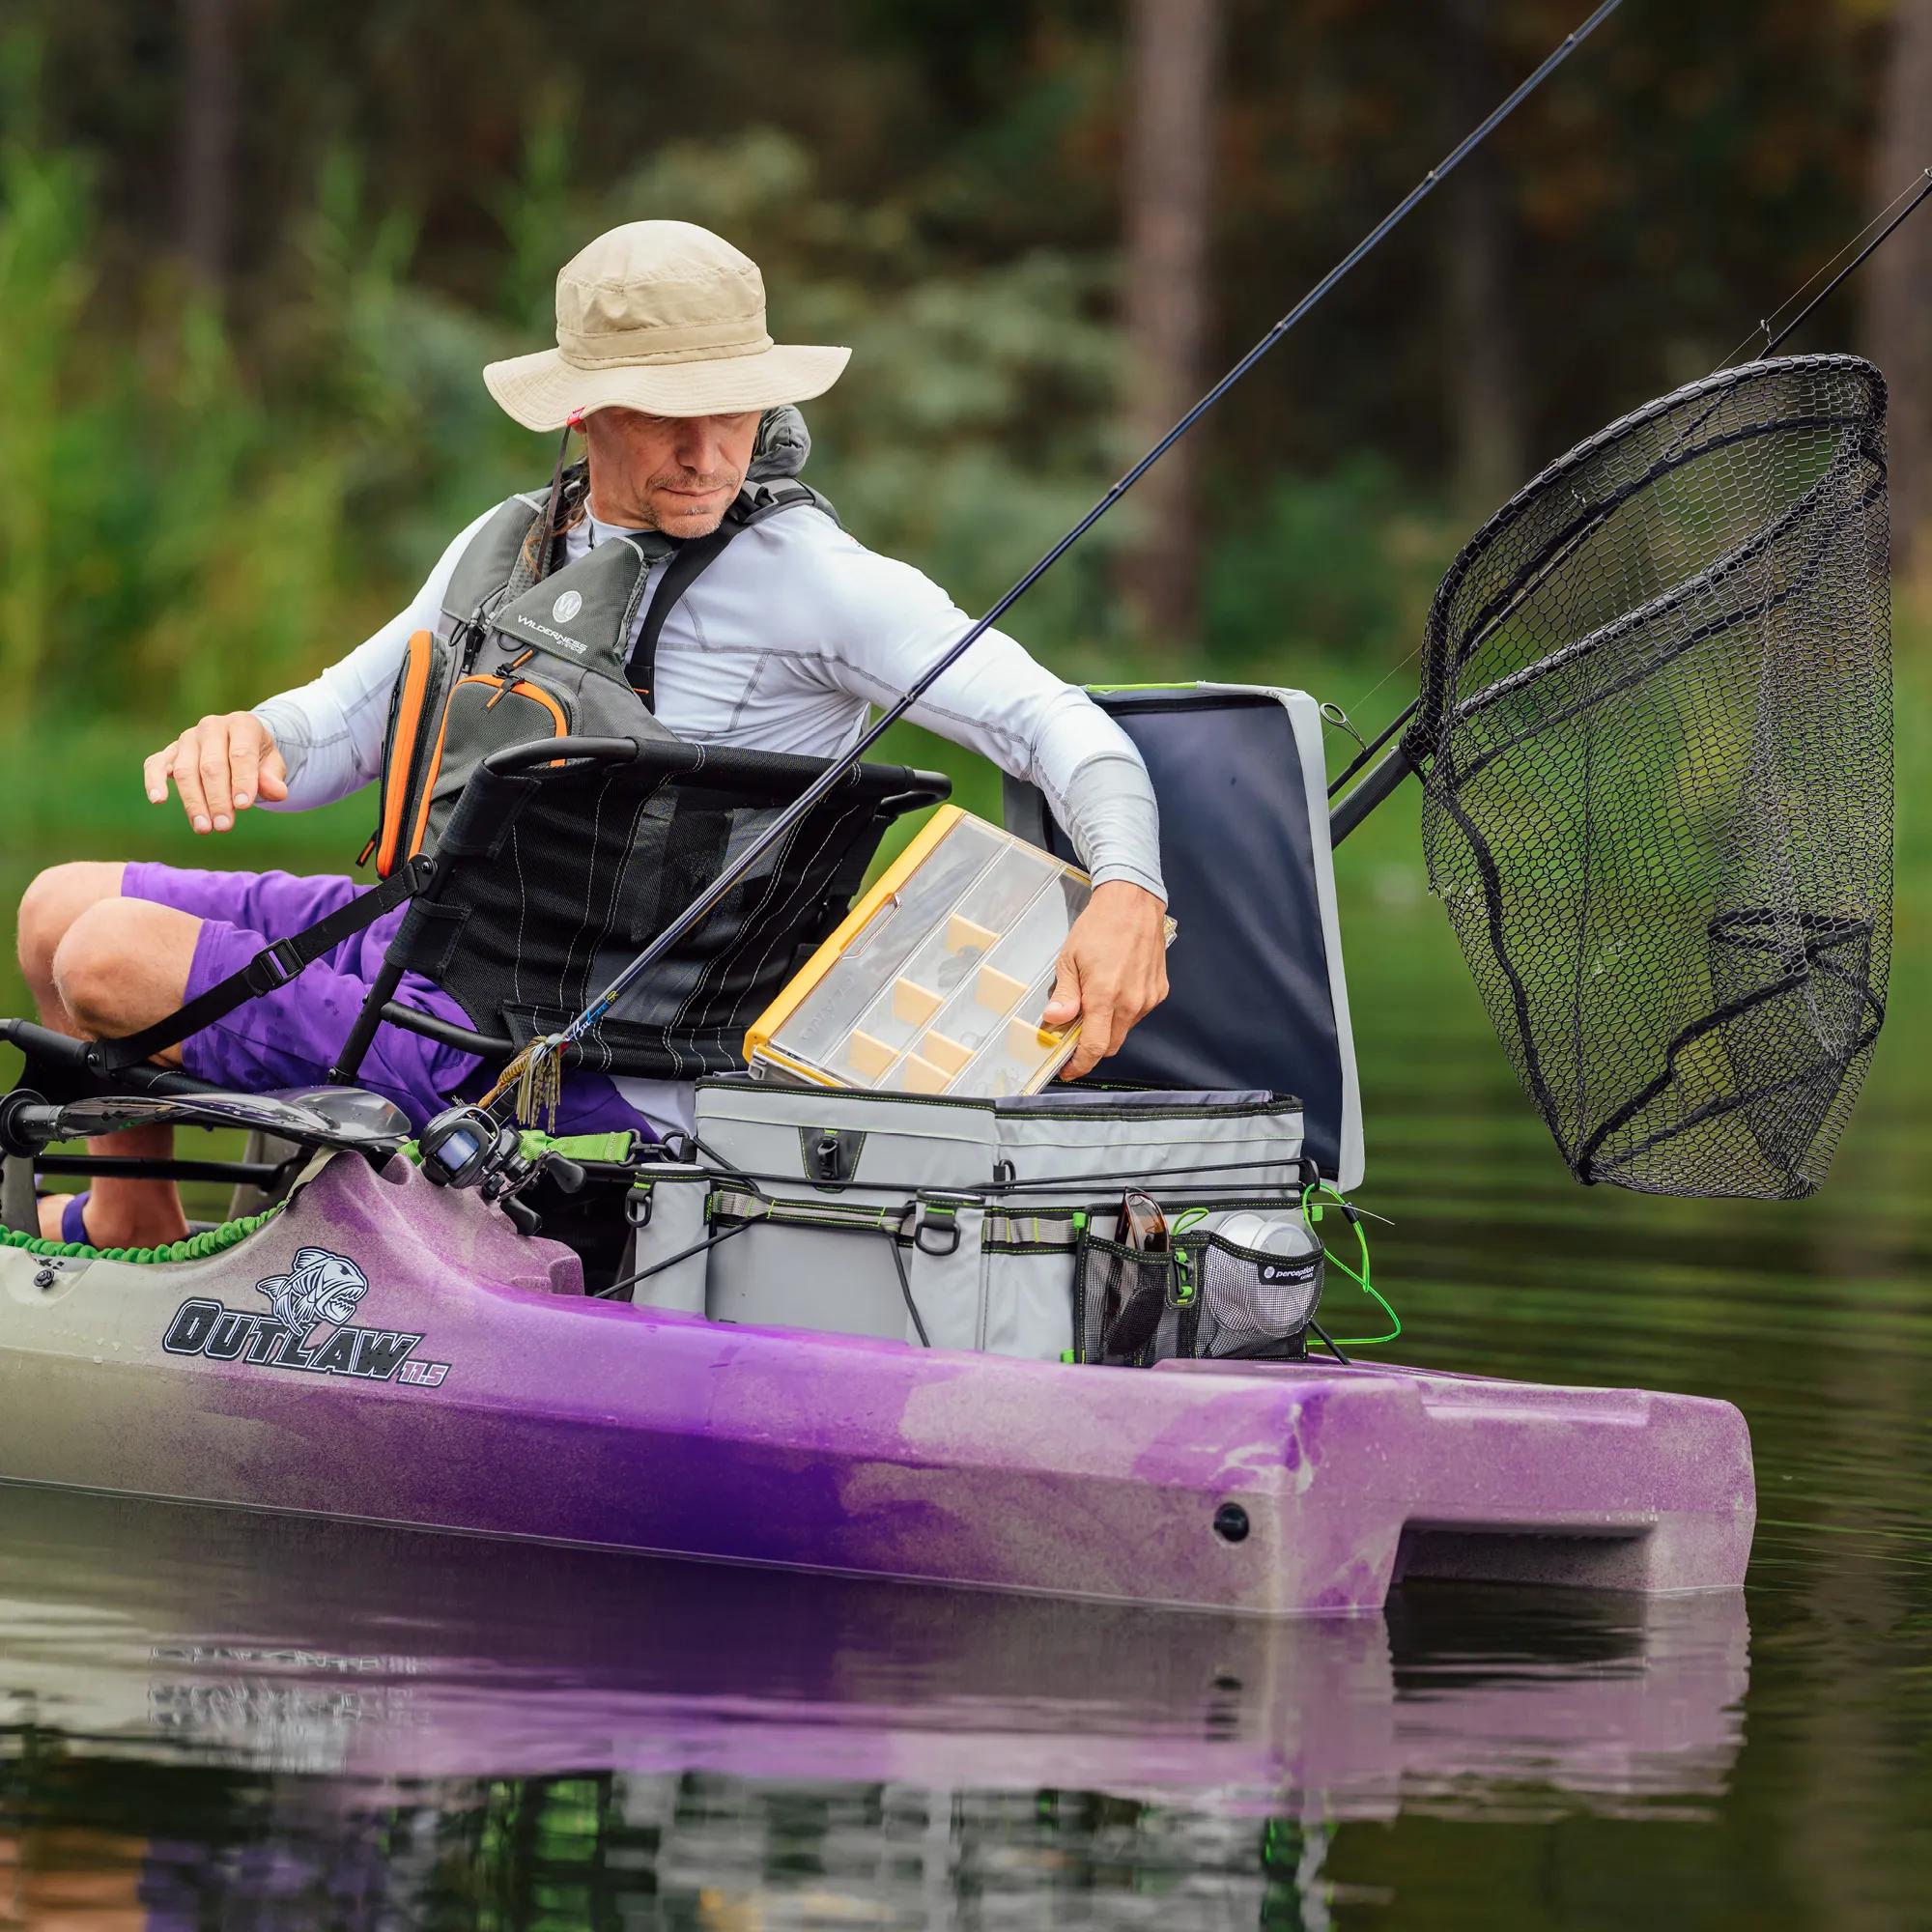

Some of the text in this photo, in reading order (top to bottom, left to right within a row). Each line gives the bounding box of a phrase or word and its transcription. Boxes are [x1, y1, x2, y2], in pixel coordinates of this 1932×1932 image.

[517, 614, 588, 651] WILDERNESS
[162, 1296, 451, 1387] OUTLAW 11.5
